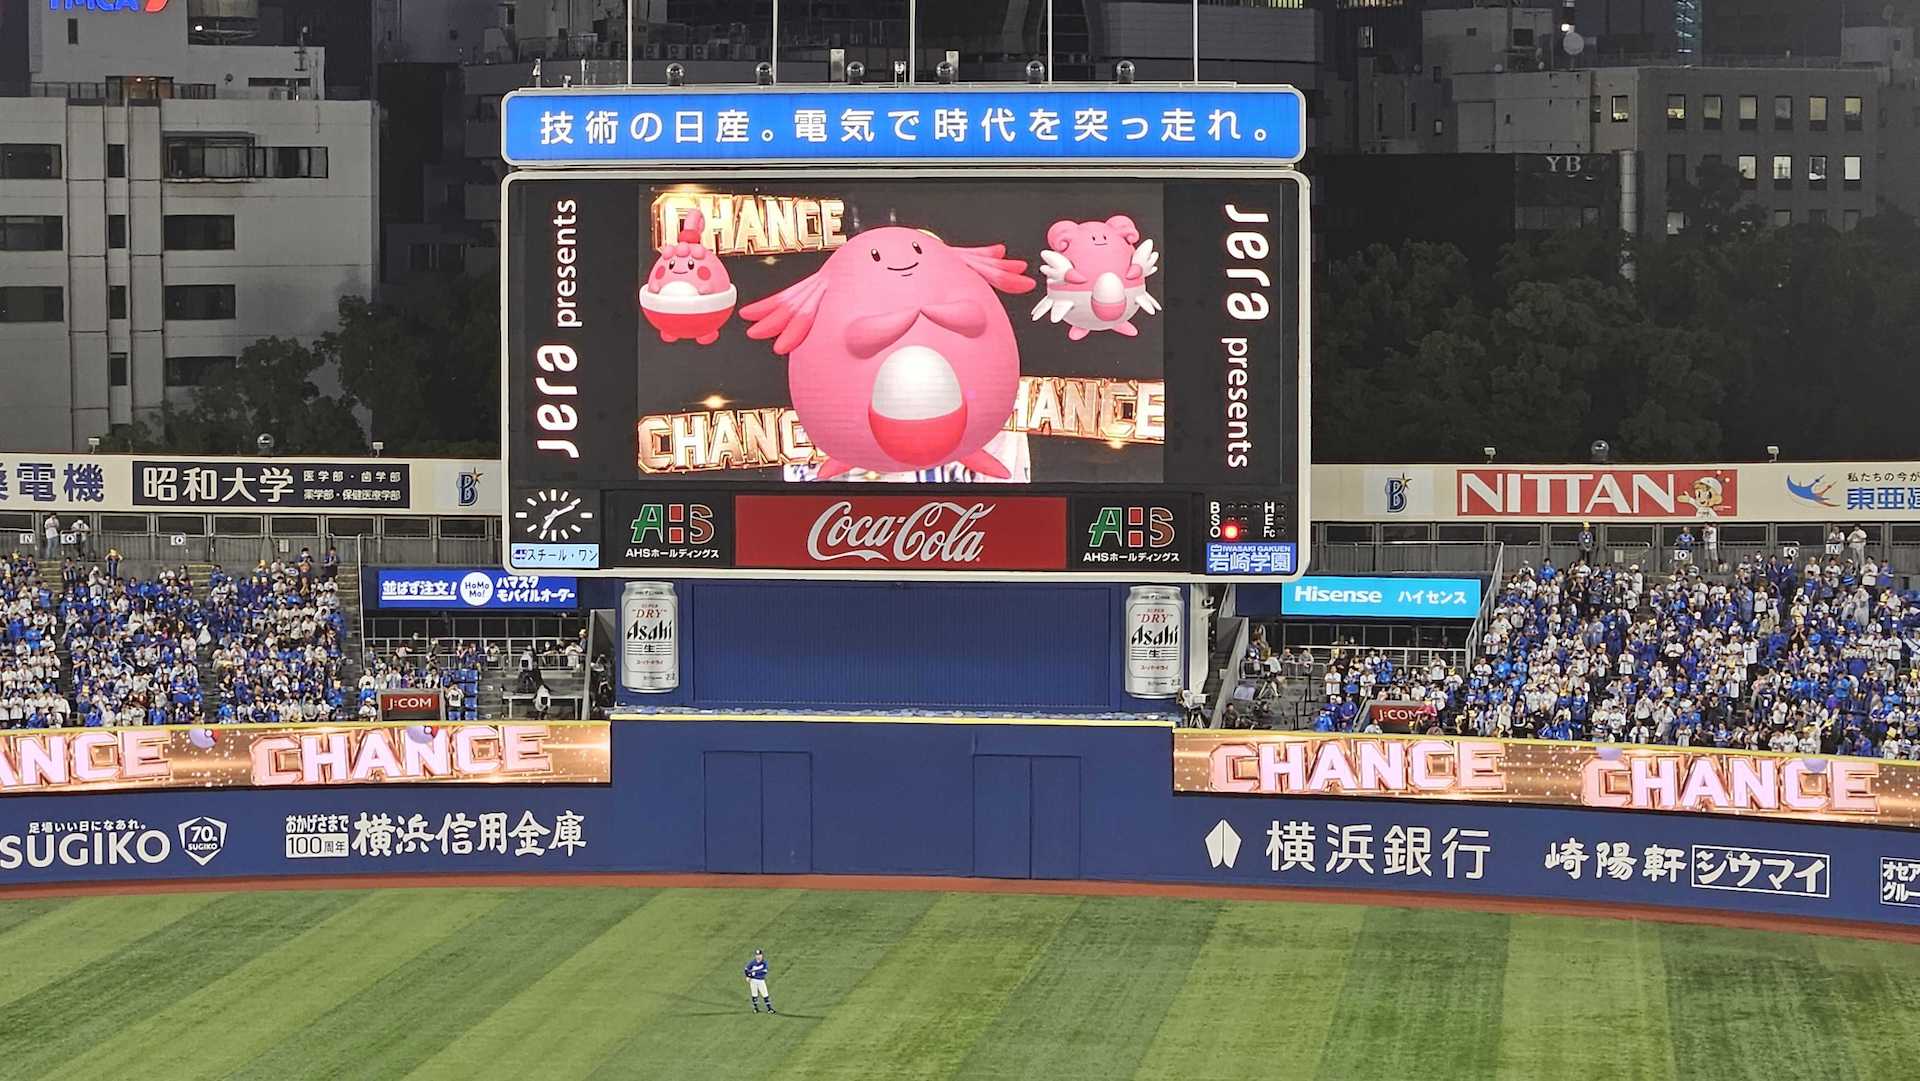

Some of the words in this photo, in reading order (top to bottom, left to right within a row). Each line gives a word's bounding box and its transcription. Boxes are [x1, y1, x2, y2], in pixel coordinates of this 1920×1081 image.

[540, 108, 1269, 144] 技術の日産。電気で時代を突っ走れ。
[1545, 155, 1582, 173] YB
[651, 192, 846, 256] CHANCE
[553, 199, 583, 328] presents
[1221, 337, 1252, 468] presents
[637, 408, 829, 474] CHANC
[0, 462, 104, 503] 電機
[142, 466, 295, 503] 昭和大学
[1461, 473, 1675, 514] NITTAN
[1210, 501, 1221, 514] B
[1264, 501, 1275, 514] H
[1210, 514, 1221, 526] S
[1264, 514, 1275, 526] E
[807, 501, 996, 562] Coca-Cola
[528, 548, 598, 562] スチール・ワン
[625, 548, 719, 559] AHSホールディングス
[1083, 552, 1180, 563] AHSホールディングス
[1209, 552, 1291, 572] 岩崎学園
[496, 576, 539, 589] ハマスタ
[497, 588, 576, 602] モバイルオーダー
[1294, 586, 1383, 603] Hisense
[1398, 590, 1467, 604] ハイセンス
[627, 620, 673, 641] Asahi
[1131, 625, 1179, 646] Asahi
[643, 644, 656, 653] 生
[1148, 649, 1161, 658] 生
[387, 697, 432, 711] J:COM
[250, 725, 553, 785] CHANCE
[1209, 740, 1507, 793] CHANCE
[1582, 755, 1881, 814] CHANCE
[28, 819, 146, 834] 足場いい日になあれ。
[286, 814, 349, 833] おかげさまで
[351, 810, 588, 857] 横浜信用金庫
[0, 830, 171, 869] SUGIKO
[288, 836, 345, 854] 100周年
[1266, 820, 1491, 879] 横浜銀行
[1545, 838, 1687, 883] 崎陽軒
